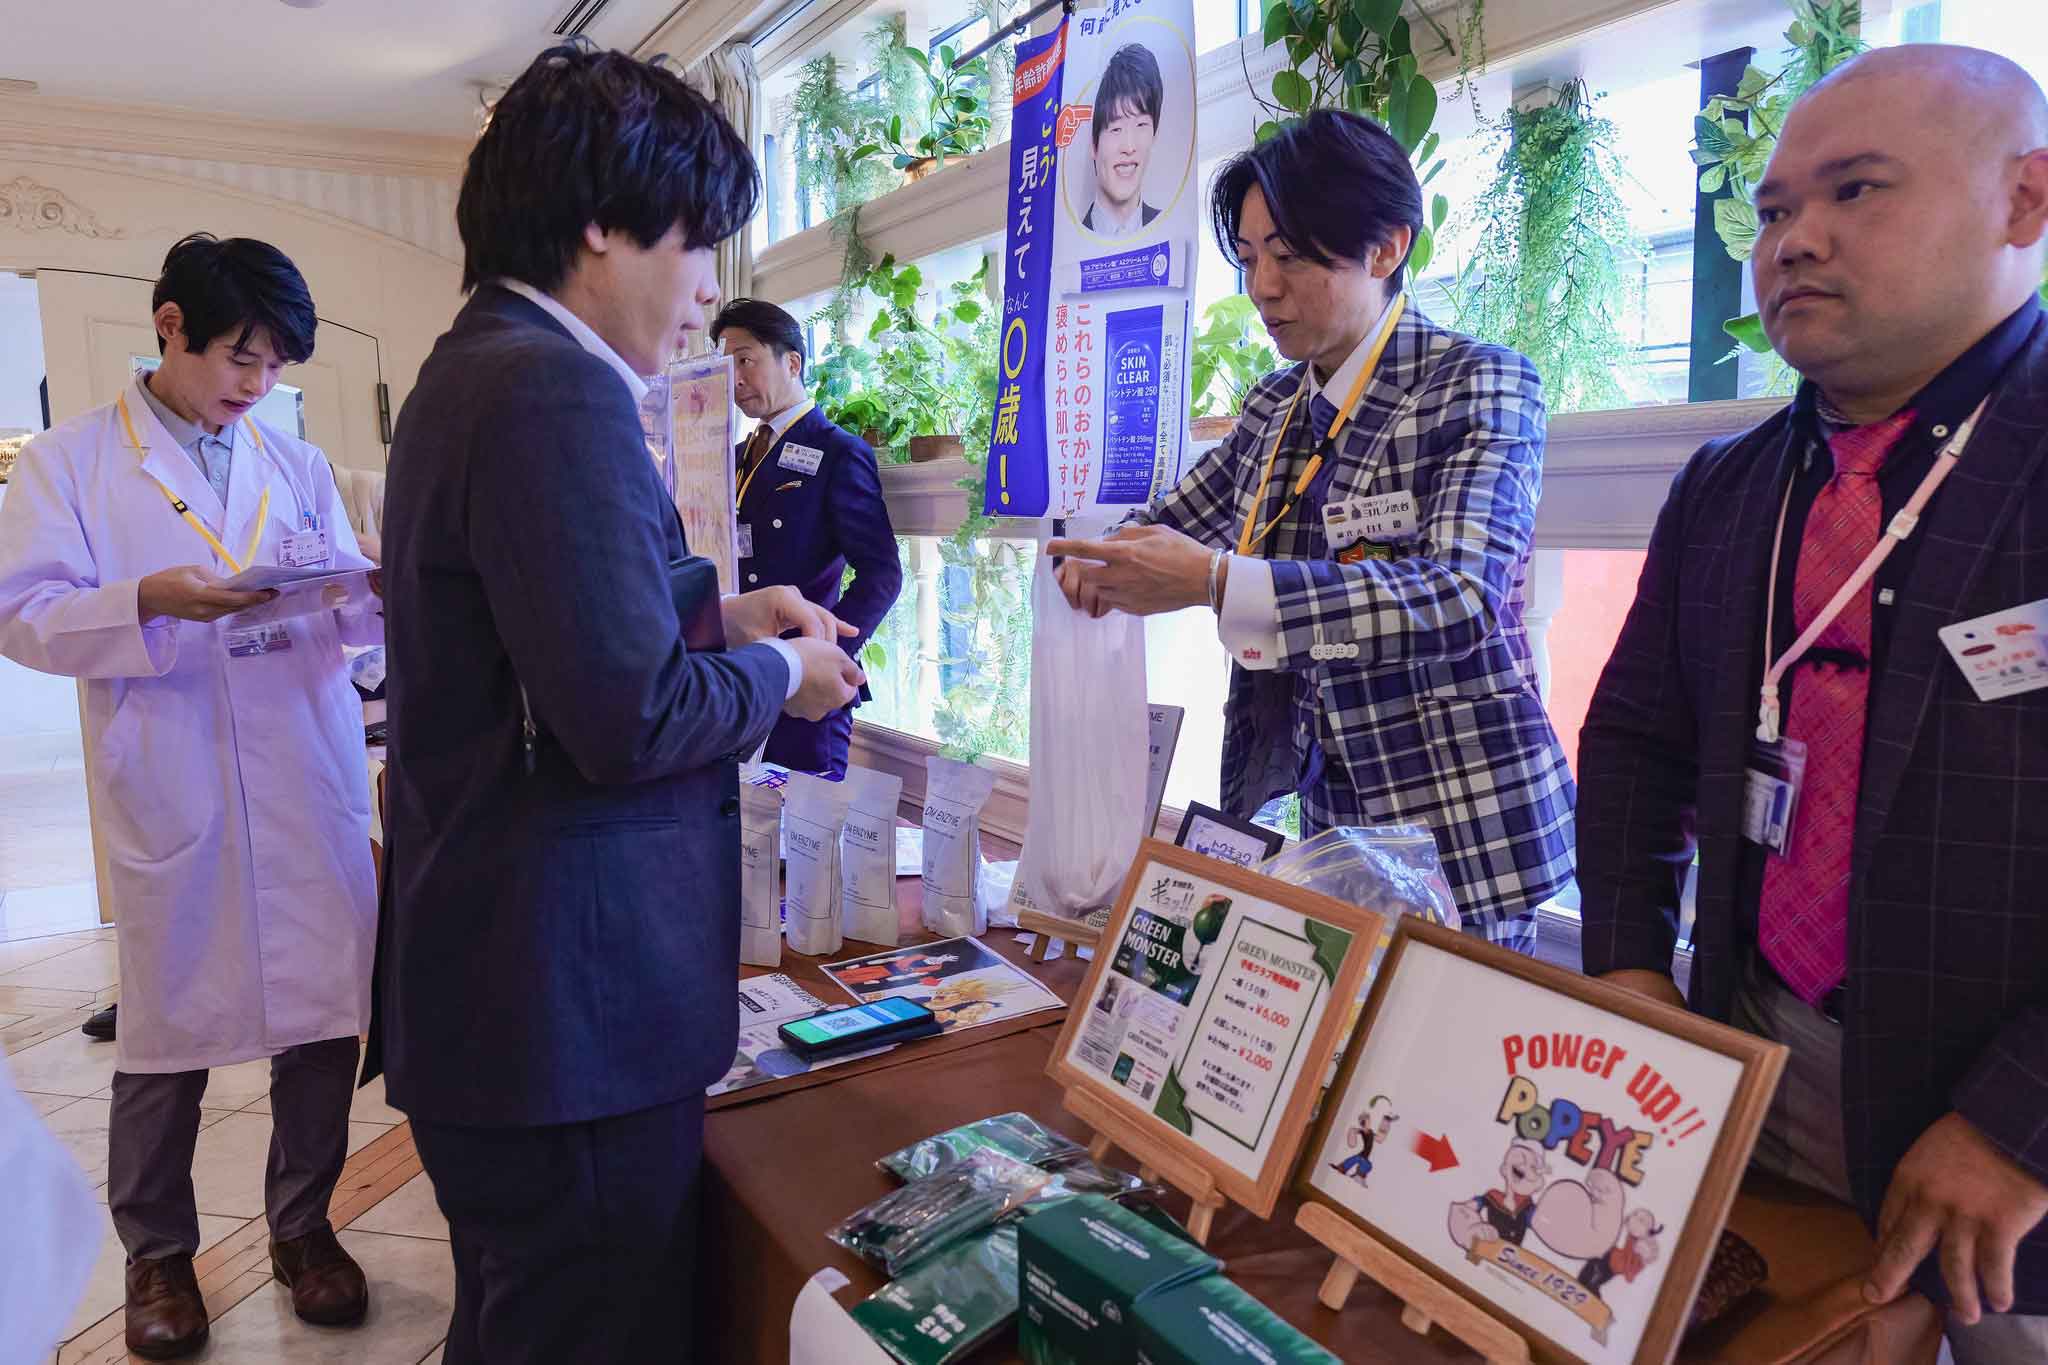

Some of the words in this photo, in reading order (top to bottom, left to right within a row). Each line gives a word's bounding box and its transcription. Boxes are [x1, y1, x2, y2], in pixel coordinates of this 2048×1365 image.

[1012, 146, 1038, 280] 見えて
[1006, 291, 1030, 315] なんと
[1116, 369, 1150, 385] CLEAR
[1121, 355, 1147, 370] SKIN
[1144, 386, 1158, 397] 250
[1073, 303, 1093, 511] これらのおかげで
[853, 825, 879, 842] ENZYME
[1131, 914, 1172, 943] GREEN
[1123, 931, 1181, 969] MONSTER
[1237, 941, 1268, 961] GREEN
[1270, 952, 1318, 982] MONSTER
[1496, 1075, 1654, 1188] POPEYE
[1541, 1272, 1588, 1303] 1929
